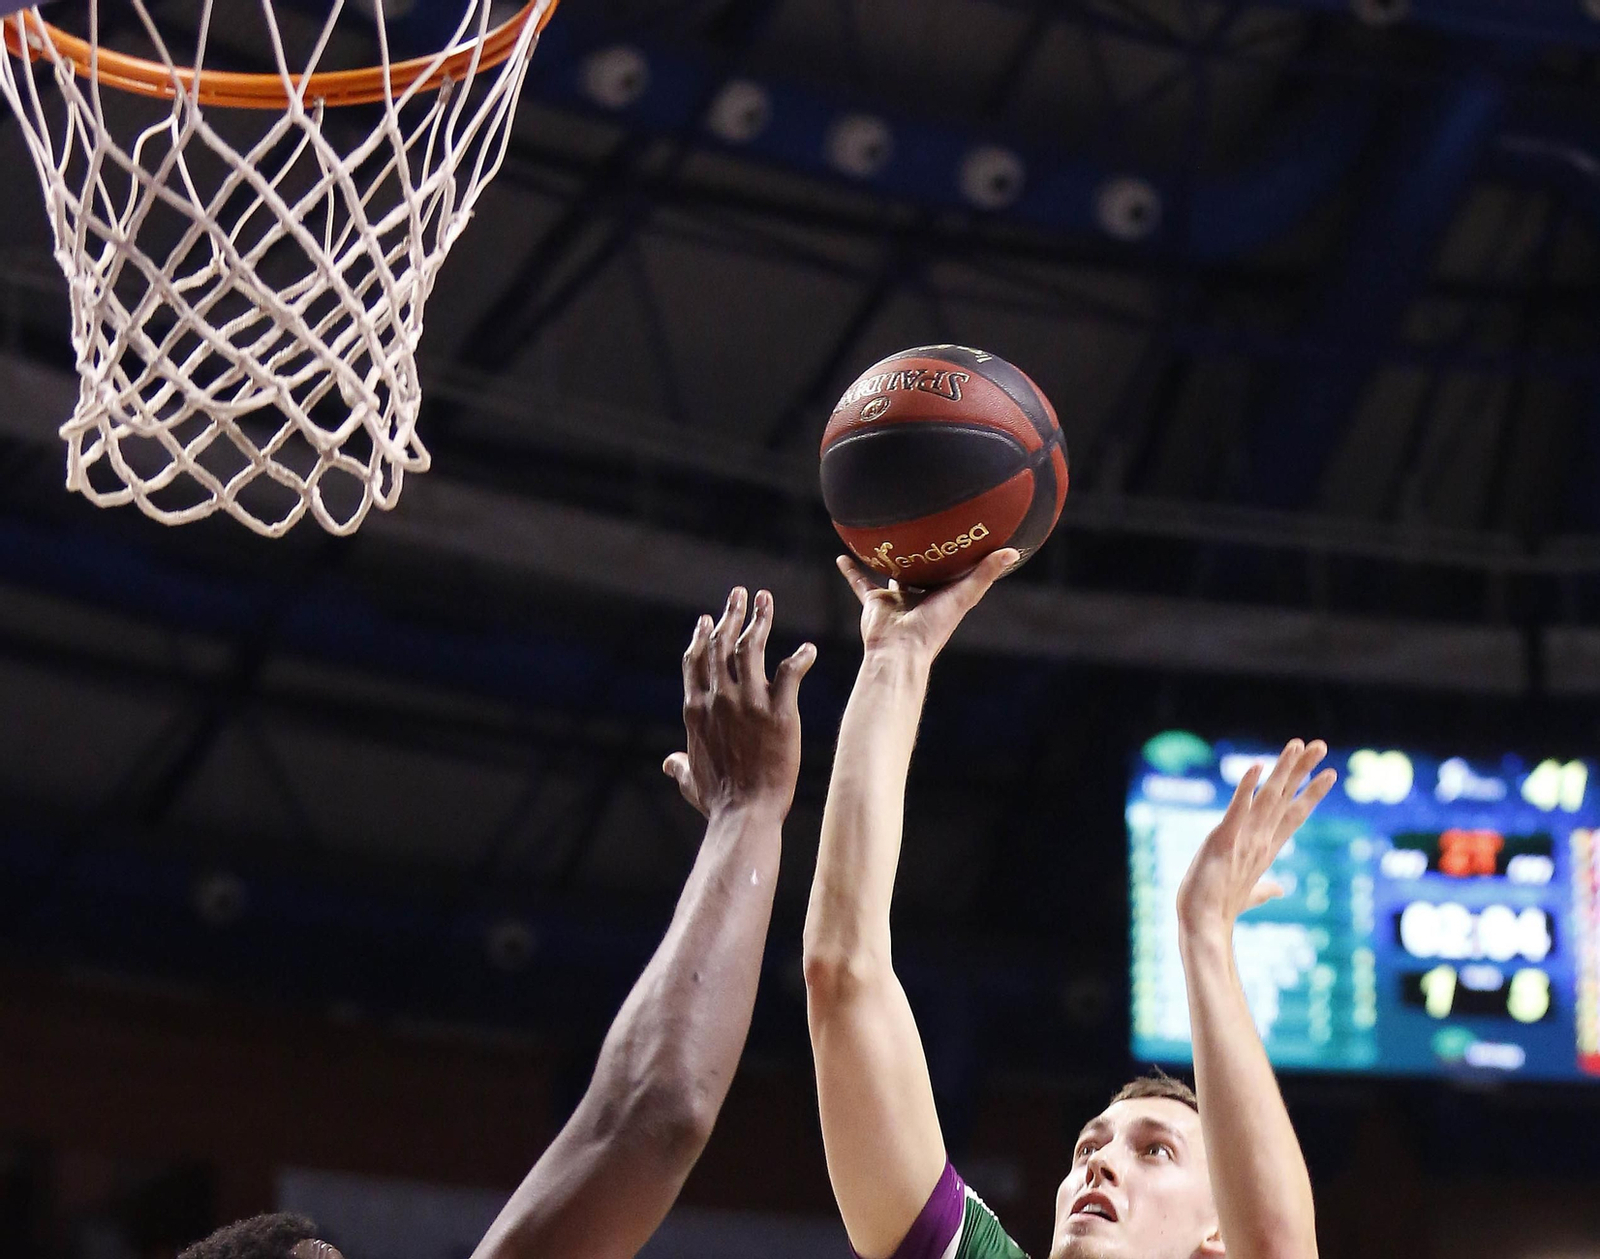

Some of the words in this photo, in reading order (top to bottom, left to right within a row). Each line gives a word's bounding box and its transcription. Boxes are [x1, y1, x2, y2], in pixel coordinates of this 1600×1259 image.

[836, 368, 971, 413] SPALDI
[895, 521, 990, 568] endesa
[1521, 759, 1588, 812] 41
